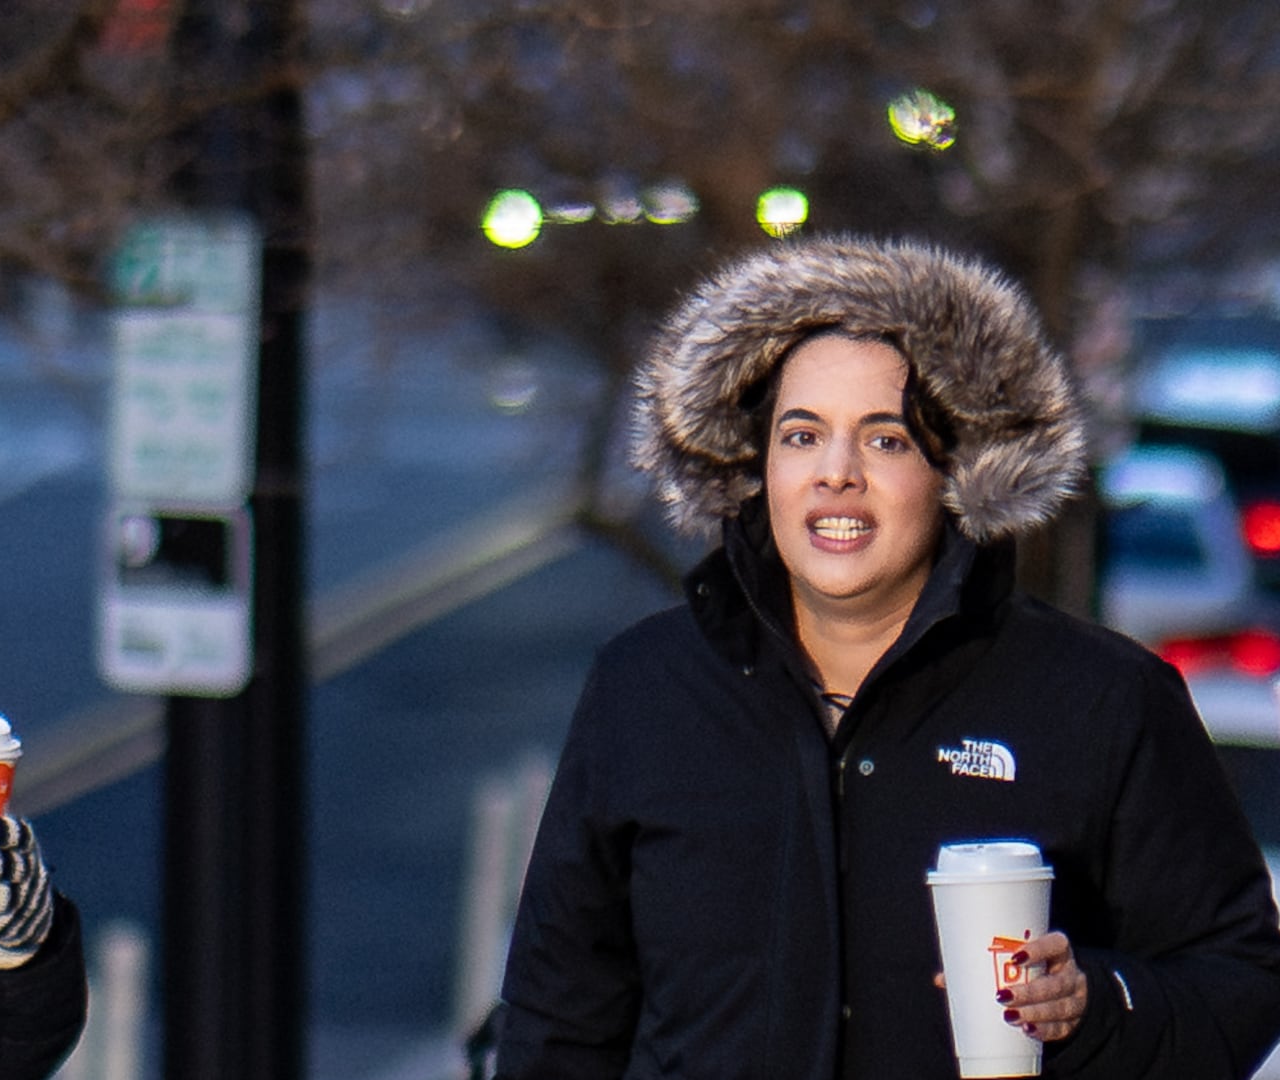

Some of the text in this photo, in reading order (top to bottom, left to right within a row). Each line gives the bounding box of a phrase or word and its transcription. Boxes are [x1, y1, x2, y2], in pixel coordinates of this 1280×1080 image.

[962, 739, 992, 754] THE
[938, 748, 991, 765] NORTH
[951, 762, 990, 778] FACE
[1004, 961, 1022, 983] D
